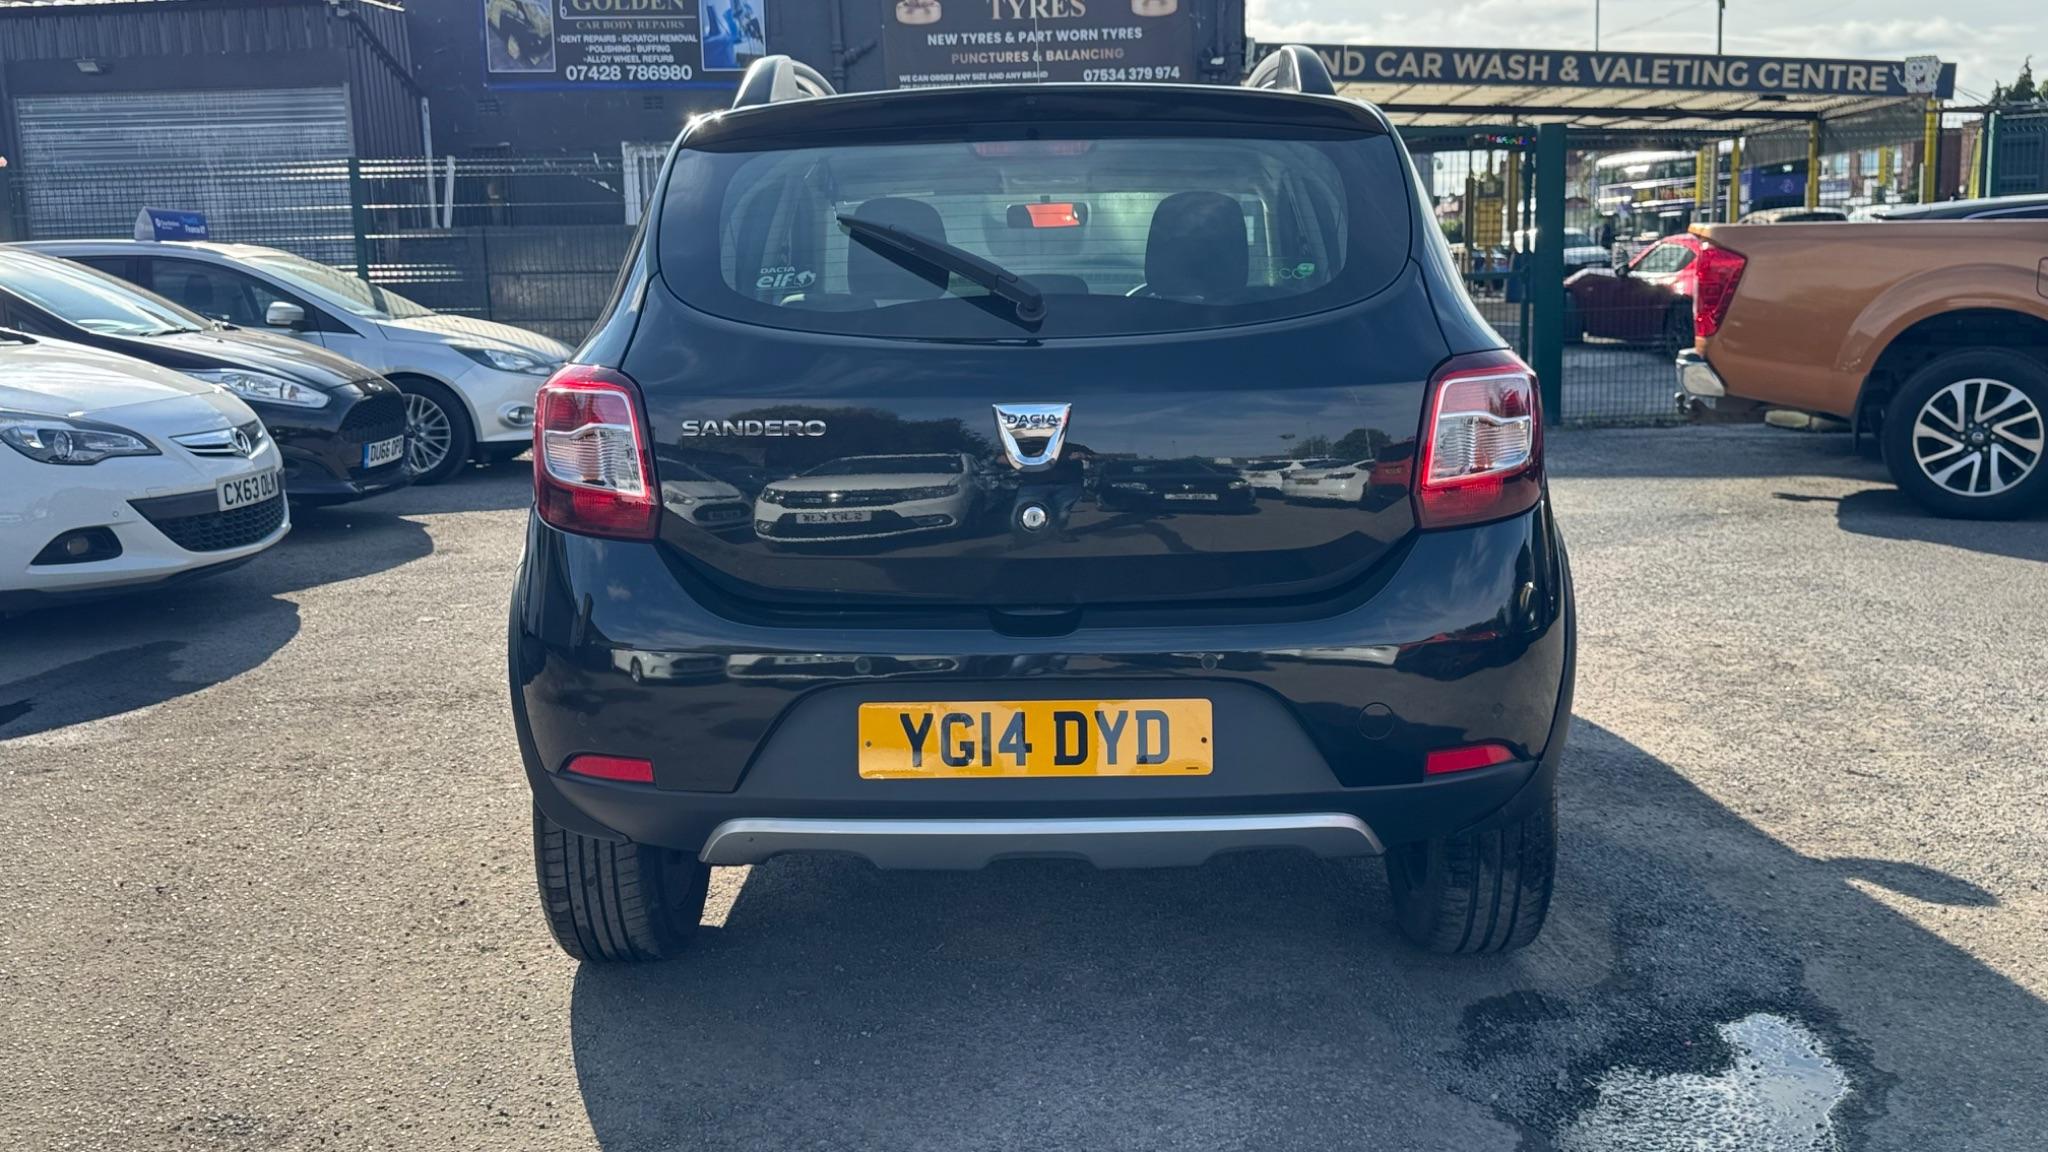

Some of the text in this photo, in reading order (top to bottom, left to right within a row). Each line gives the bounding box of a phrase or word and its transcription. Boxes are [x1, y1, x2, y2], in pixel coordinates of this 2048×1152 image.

[572, 0, 685, 11] GOLDEN
[986, 0, 1087, 20] TYRES
[576, 20, 685, 30] CAR BODY REPAIRS
[583, 34, 617, 43] REPAIRS
[622, 34, 659, 42] SCRATCH
[661, 34, 698, 42] REMOVAL
[927, 27, 1143, 46] NEW TYRES & PART WORN TYRES
[586, 55, 611, 63] ALLOY
[614, 54, 641, 63] WHEEL
[951, 48, 1124, 64] PUNCTURES & BALANCING
[566, 65, 693, 80] 07428 786980
[930, 74, 955, 82] ORDER
[955, 73, 971, 81] ANY
[988, 72, 1005, 80] AND
[1083, 66, 1180, 81] 07534 379 974
[1375, 51, 1443, 78] CAR
[1453, 53, 1549, 80] WASH
[1559, 56, 1580, 81] &
[1589, 57, 1749, 87] VALETING
[1758, 65, 1889, 92] CENTRE
[756, 273, 795, 288] elf
[1007, 414, 1058, 424] DACIA
[681, 419, 827, 437] SANDERO
[370, 441, 391, 461] DU66
[223, 476, 259, 505] CX63
[899, 709, 1170, 767] YG14 DYD
